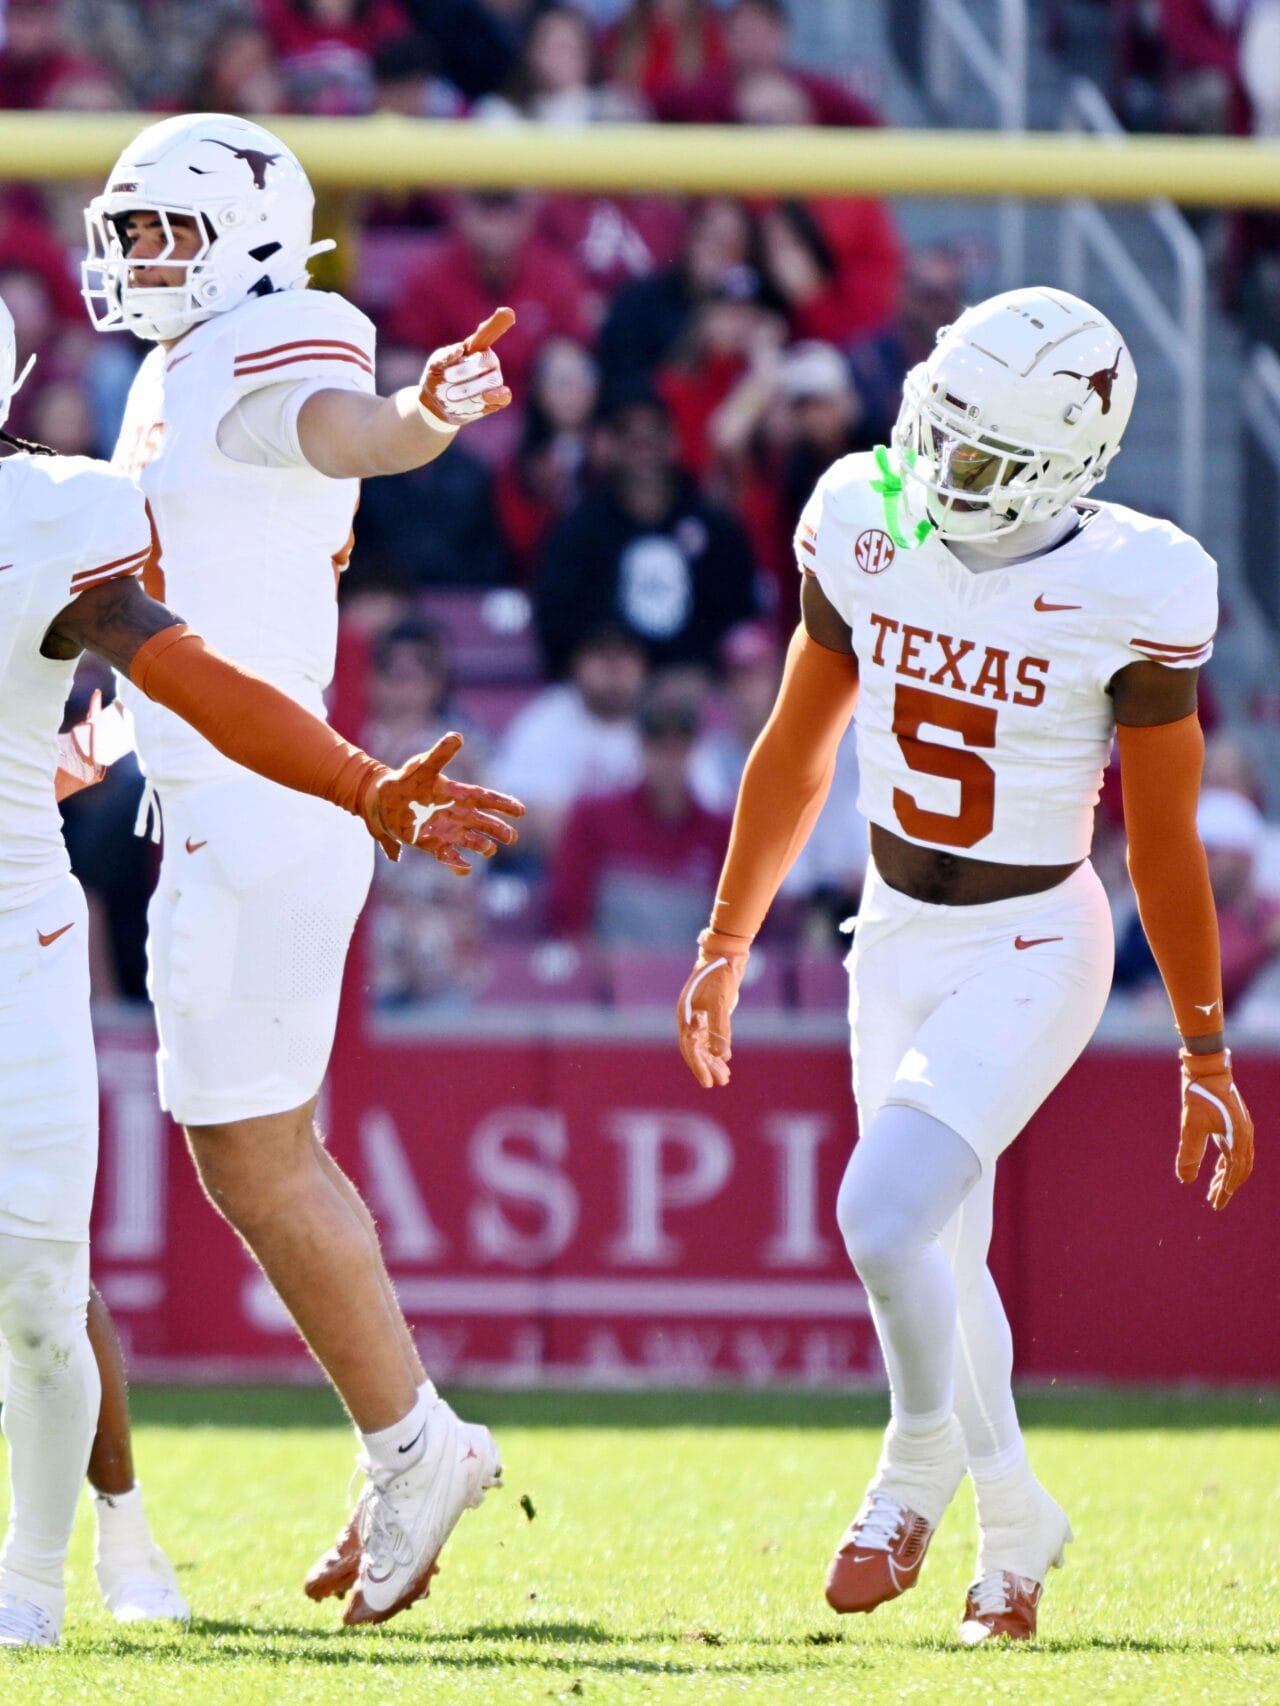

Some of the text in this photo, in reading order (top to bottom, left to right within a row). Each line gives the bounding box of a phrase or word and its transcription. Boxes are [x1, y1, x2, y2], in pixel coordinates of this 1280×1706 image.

[855, 529, 895, 574] SEC
[871, 613, 1050, 707] TEXAS
[892, 683, 998, 848] 5
